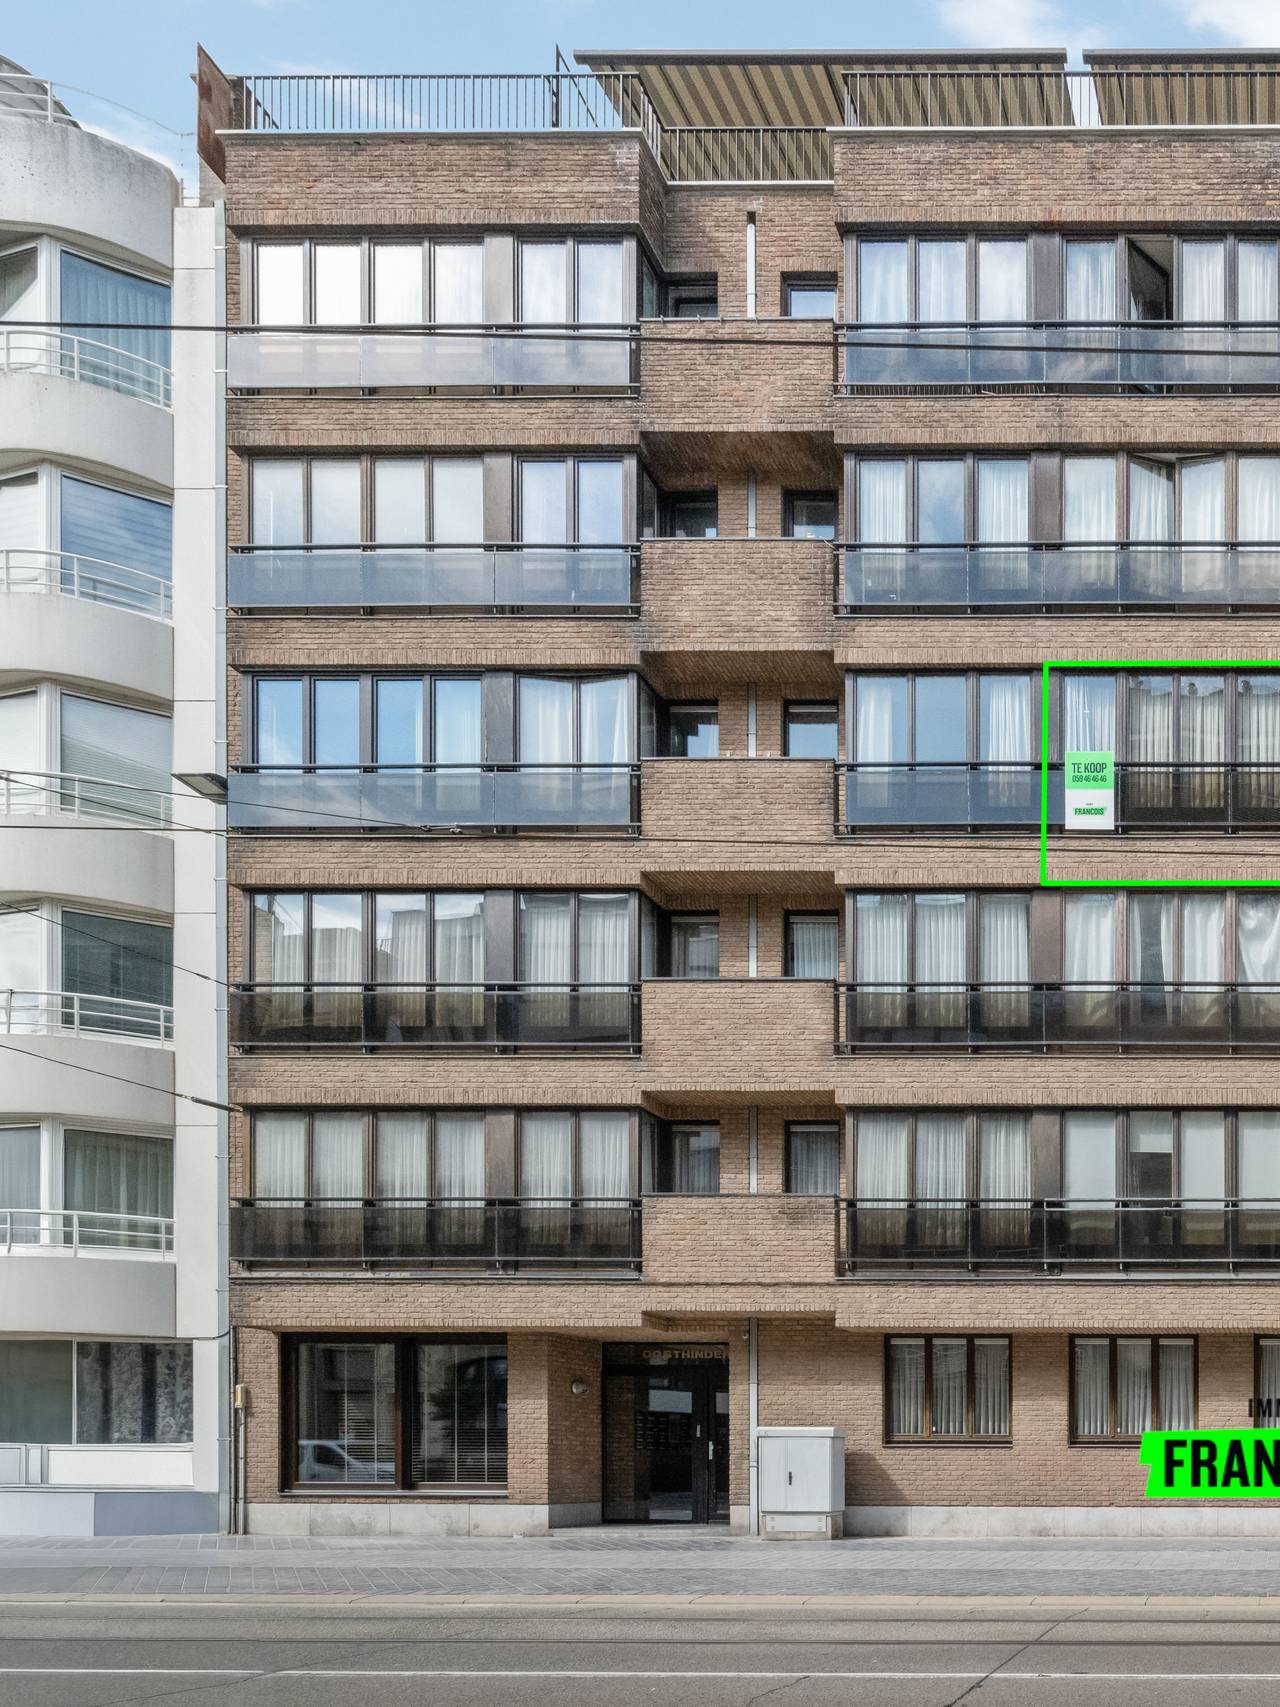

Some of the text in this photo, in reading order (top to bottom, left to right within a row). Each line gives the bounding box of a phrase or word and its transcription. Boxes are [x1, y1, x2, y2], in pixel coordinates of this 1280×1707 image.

[1071, 762, 1107, 773] TE KOOP
[1074, 807, 1105, 816] FRANCOIS
